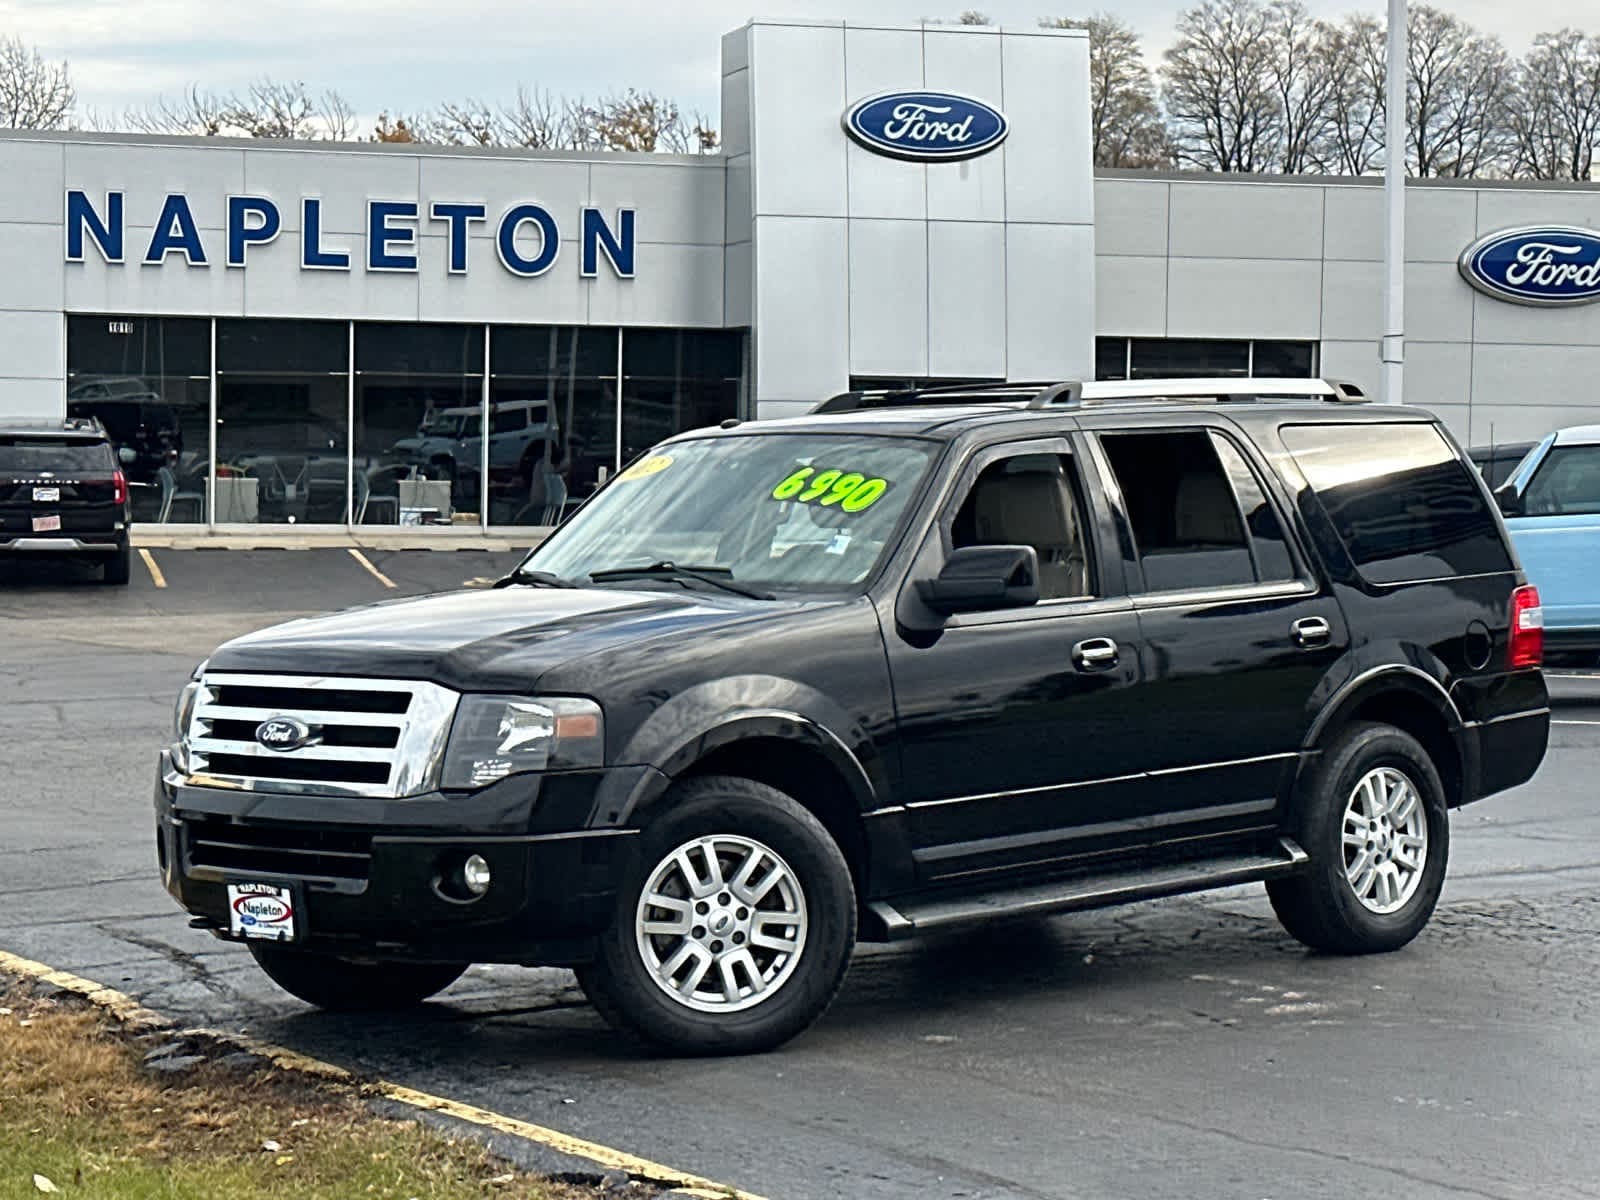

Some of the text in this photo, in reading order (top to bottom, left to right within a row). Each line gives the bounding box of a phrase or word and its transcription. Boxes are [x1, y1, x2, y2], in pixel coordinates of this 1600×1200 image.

[884, 102, 974, 142] Ford
[64, 188, 637, 279] NAPLETON
[1506, 242, 1600, 287] Ford
[772, 467, 887, 512] 6990
[262, 722, 293, 742] Ford
[243, 901, 283, 917] Napleton
